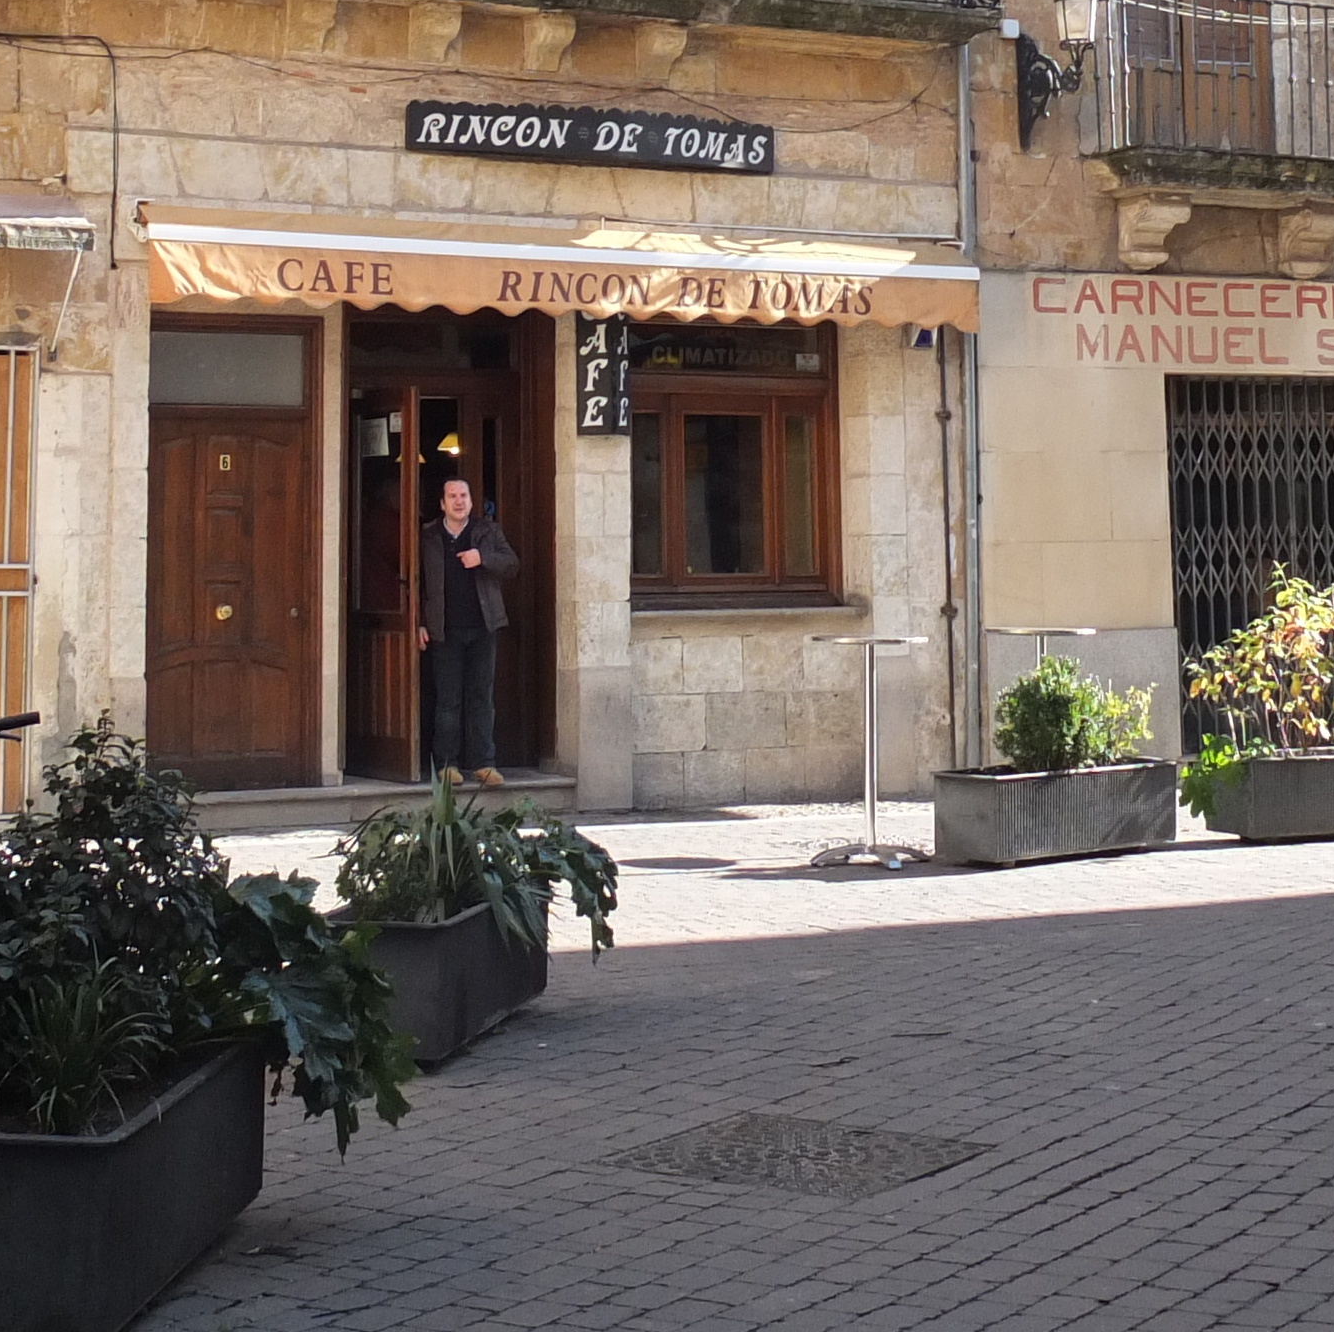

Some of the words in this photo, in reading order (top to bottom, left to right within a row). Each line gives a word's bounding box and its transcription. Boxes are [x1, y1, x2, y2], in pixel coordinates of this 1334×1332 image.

[417, 113, 572, 148] RINCON
[594, 122, 643, 153] DE
[664, 127, 767, 165] TOMAS
[277, 259, 393, 295] CAFE
[497, 270, 651, 307] RINCON
[678, 280, 726, 309] DE
[748, 279, 873, 315] TOMAS
[651, 345, 789, 365] CLIMATIZADO
[1077, 324, 1289, 365] MANUEL
[222, 456, 229, 469] 6
